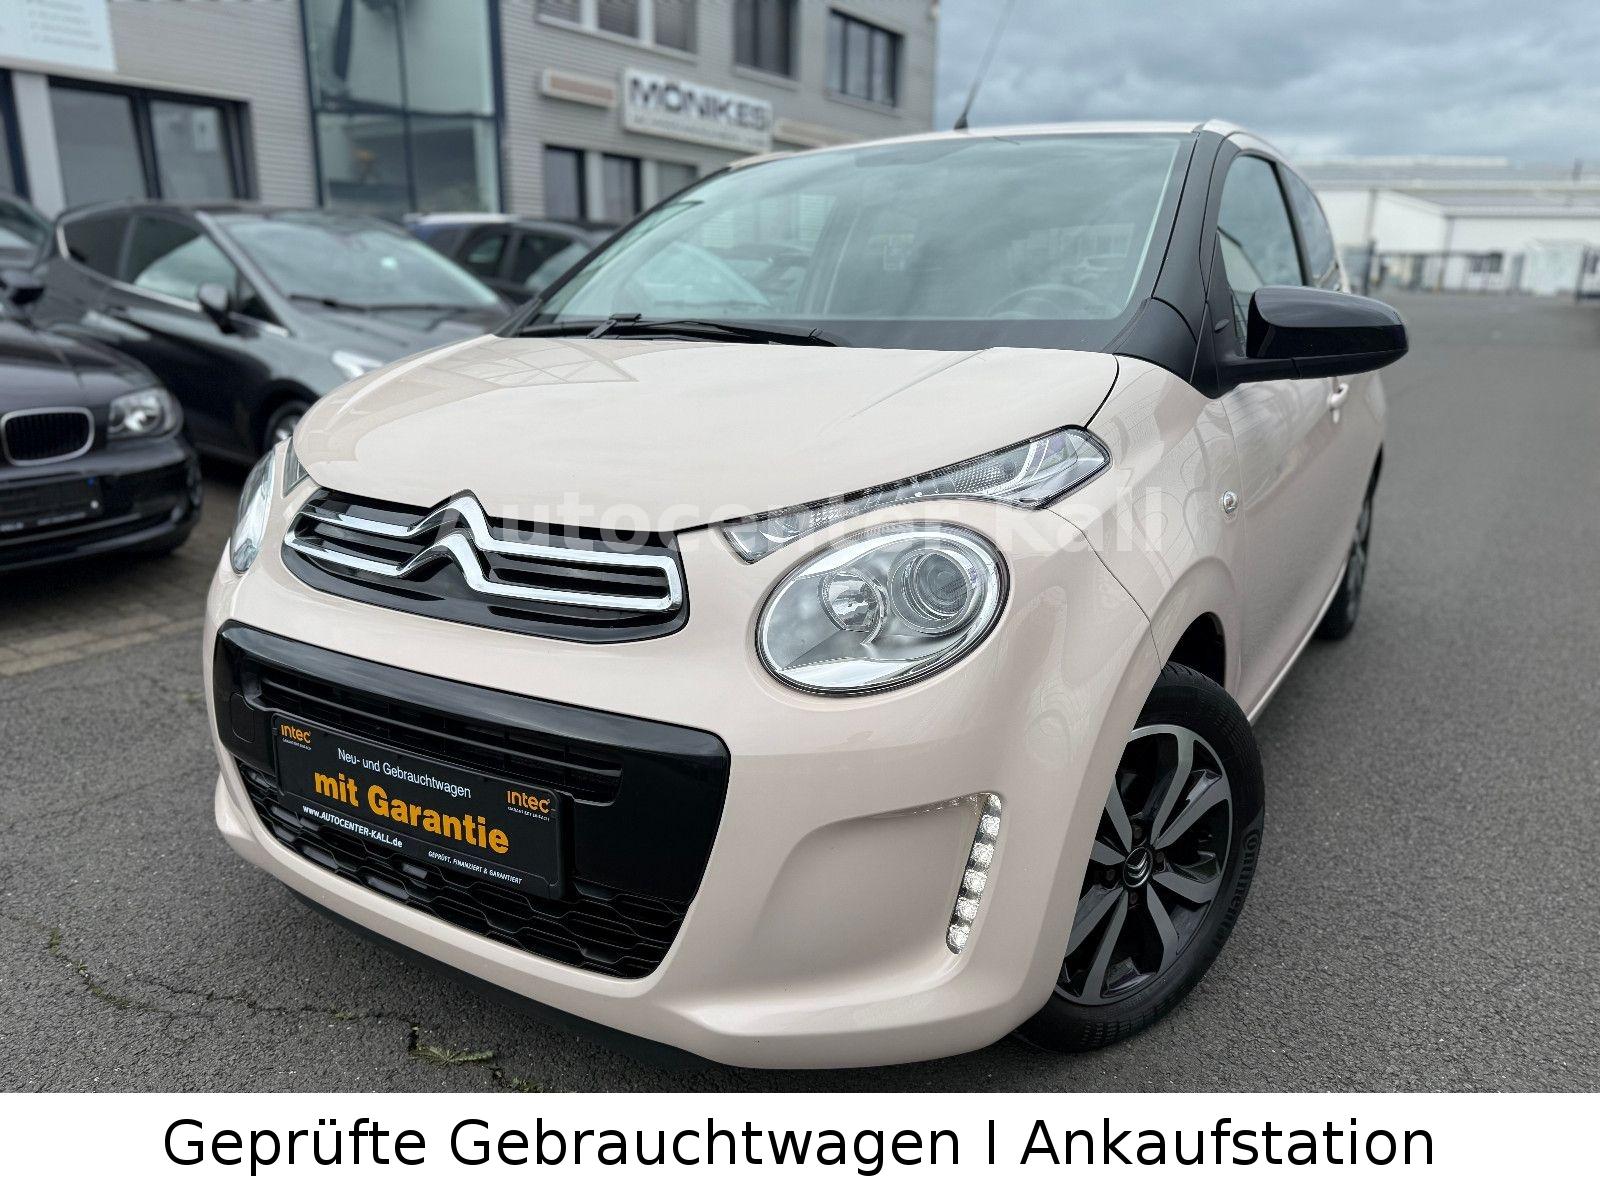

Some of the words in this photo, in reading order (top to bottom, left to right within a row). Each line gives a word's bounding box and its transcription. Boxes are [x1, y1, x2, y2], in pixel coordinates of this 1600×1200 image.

[337, 747, 361, 765] Neu-
[362, 757, 381, 772] und
[383, 762, 472, 799] Gebrauchtwagen
[302, 804, 403, 849] www.AUTOCENTER-KALL.de
[314, 772, 359, 807] mit
[367, 784, 510, 854] Garantie
[453, 858, 483, 874] FINANZIERT
[489, 869, 523, 885] GARANTIERT
[1214, 830, 1262, 943] Continent
